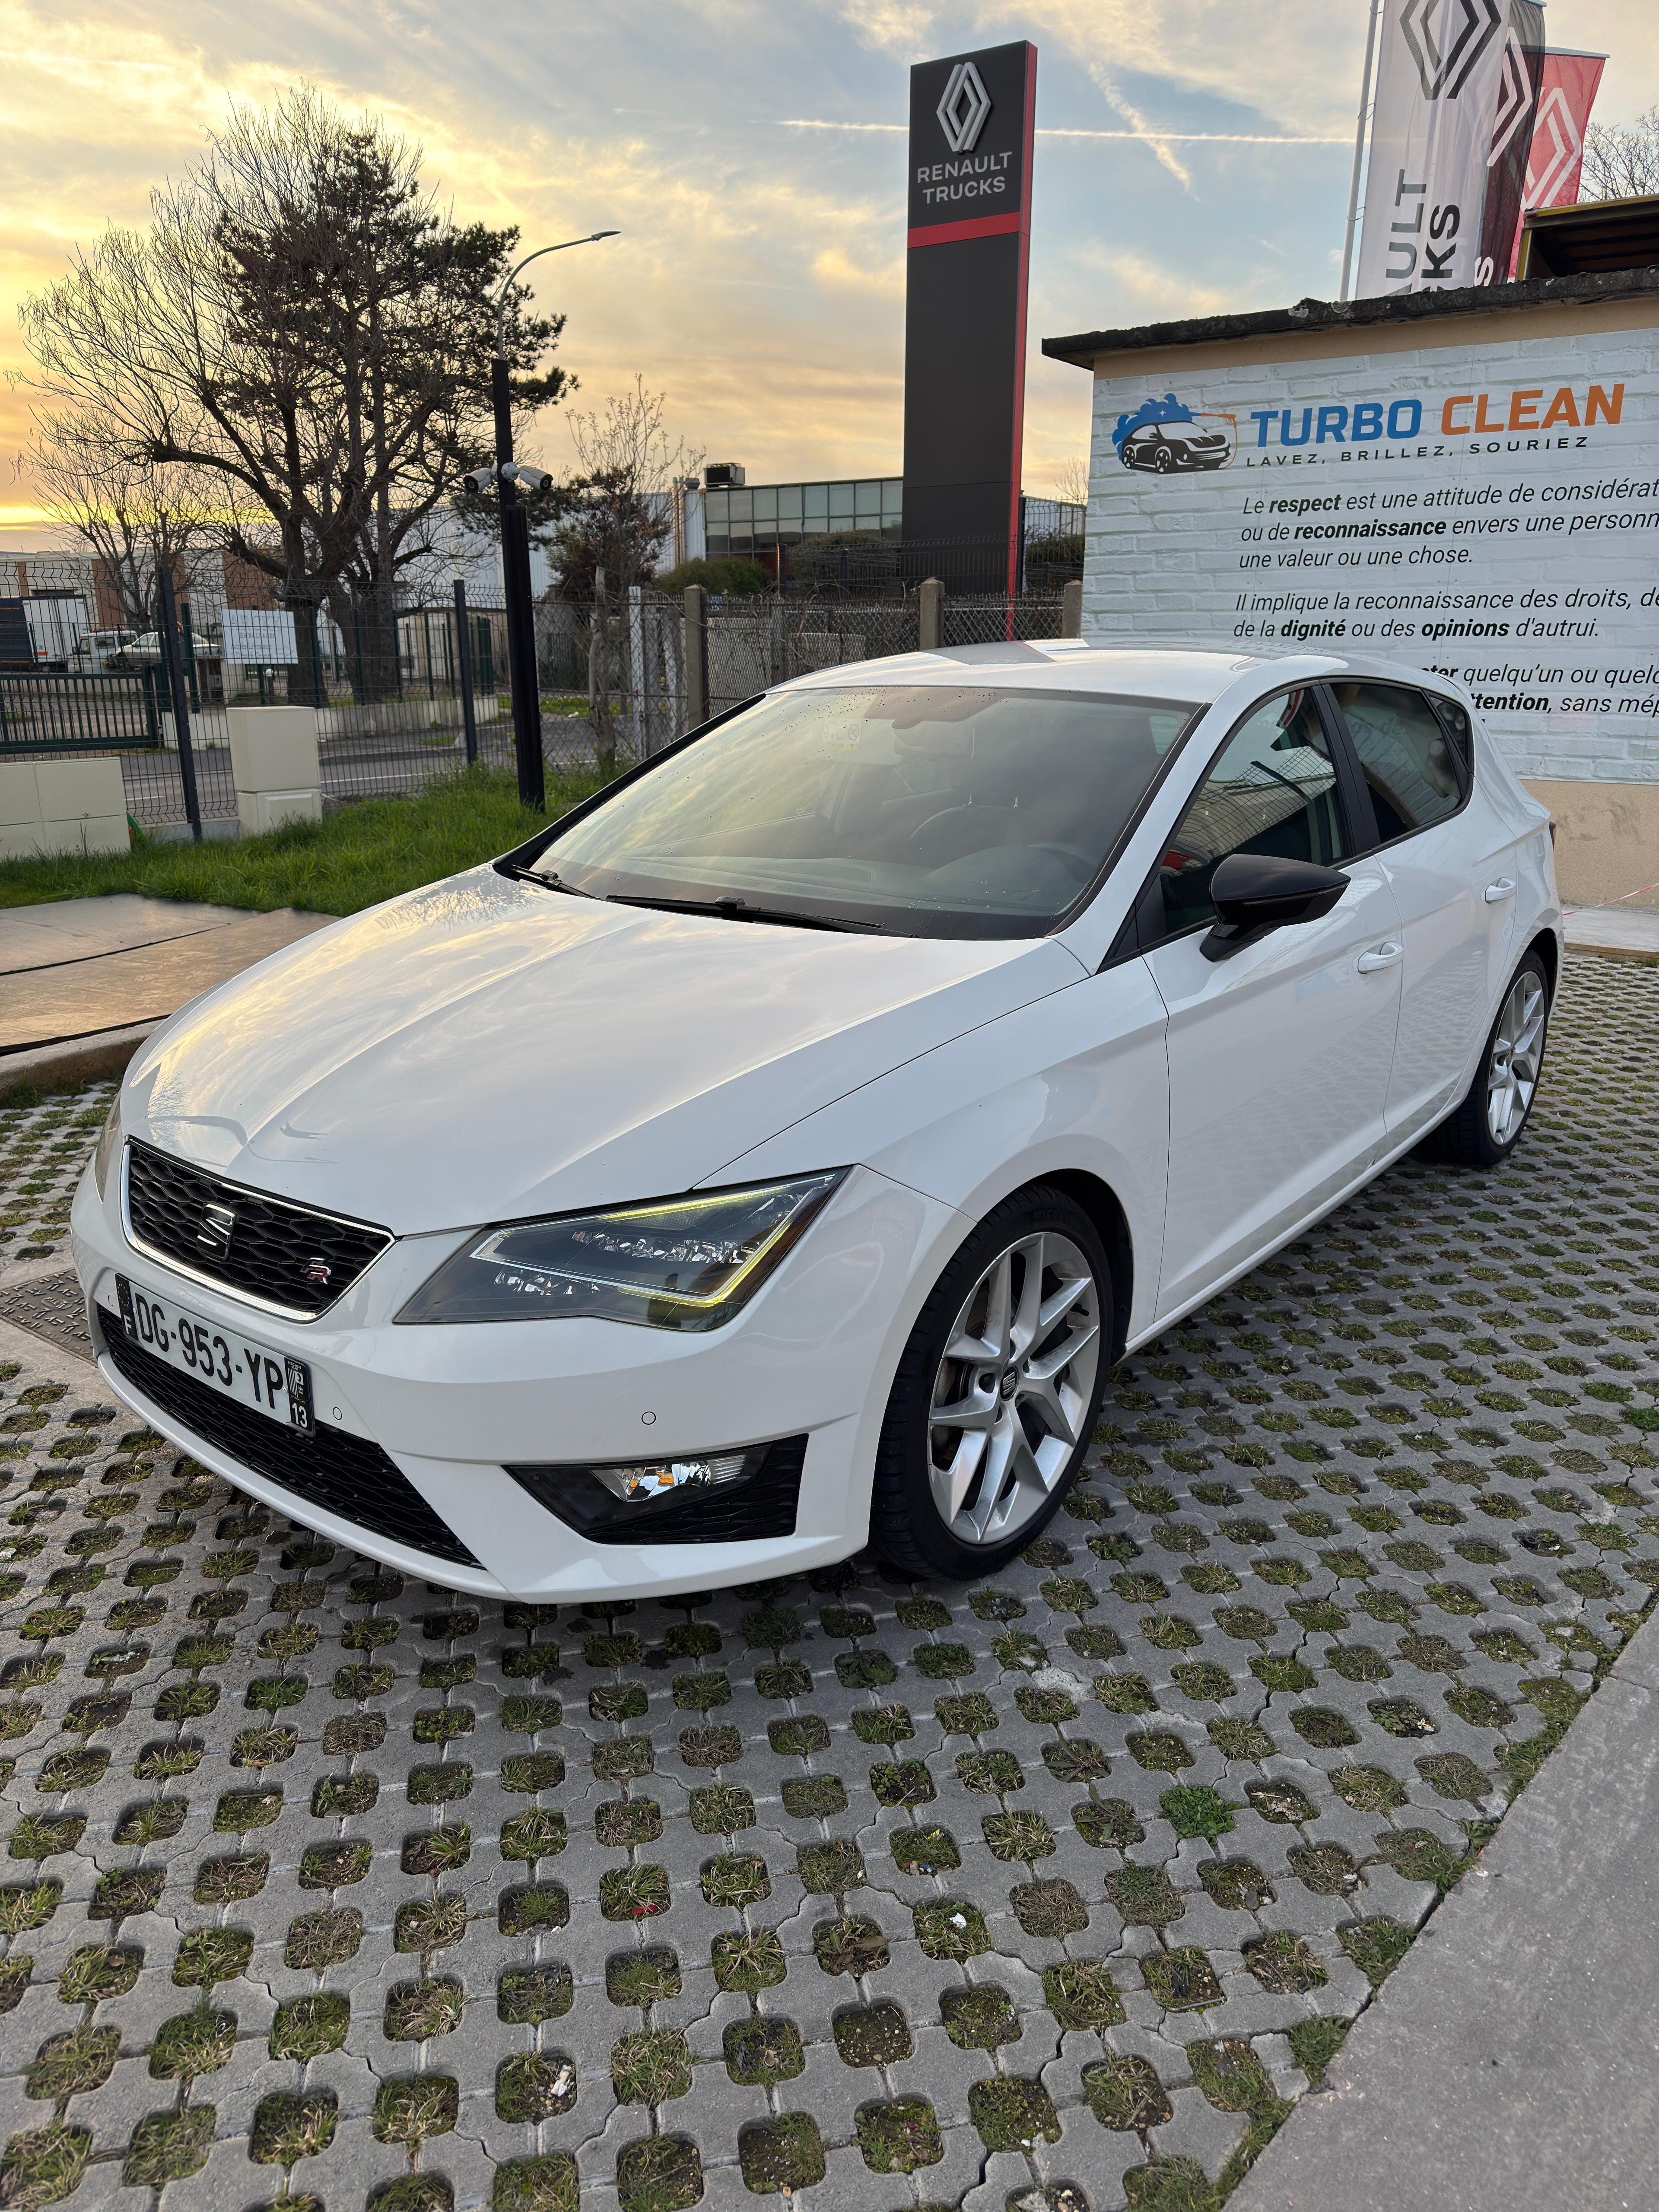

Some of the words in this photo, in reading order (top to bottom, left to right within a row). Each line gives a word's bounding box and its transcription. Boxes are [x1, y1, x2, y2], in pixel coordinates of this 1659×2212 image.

[917, 151, 1012, 184] RENAULT
[922, 176, 1006, 204] TRUCKS
[1420, 204, 1460, 292] KS
[1251, 399, 1422, 448] TURBO
[1441, 384, 1624, 435] CLEAN
[1246, 454, 1325, 467] LAVEZ,
[1341, 445, 1452, 462] BRILLEZ,
[1469, 437, 1587, 454] SOURIEZ
[1243, 497, 1264, 514] Le
[1269, 494, 1341, 517] respect
[1346, 493, 1376, 510] est
[1382, 493, 1417, 509] une
[1423, 485, 1502, 507] attitude
[1509, 483, 1535, 503] de
[1241, 528, 1263, 541] ou
[1268, 522, 1290, 540] de
[1294, 518, 1446, 540] reconnaissance
[1452, 518, 1519, 534] envers
[1526, 516, 1564, 532] une
[1568, 513, 1659, 535] personn
[1239, 555, 1271, 568] une
[1278, 549, 1333, 567] valeur
[1338, 552, 1362, 566] ou
[1367, 551, 1402, 565] une
[1408, 545, 1472, 564] chose.
[1236, 593, 1247, 611] Il
[1251, 593, 1328, 615] implique
[1334, 592, 1350, 610] la
[1355, 591, 1513, 610] reconnaissance
[1520, 589, 1558, 608] des
[1565, 588, 1631, 610] droits,
[1234, 620, 1255, 637] de
[1260, 620, 1275, 637] la
[1281, 619, 1346, 641] dignité
[1351, 624, 1376, 637] ou
[1381, 619, 1415, 637] des
[1421, 618, 1510, 641] opinions
[1571, 669, 1598, 683] ou
[1560, 698, 1612, 712] sans
[300, 1257, 332, 1284] FR
[124, 1314, 132, 1335] F
[134, 1292, 284, 1409] DG-953-YP
[292, 1402, 308, 1428] 13
